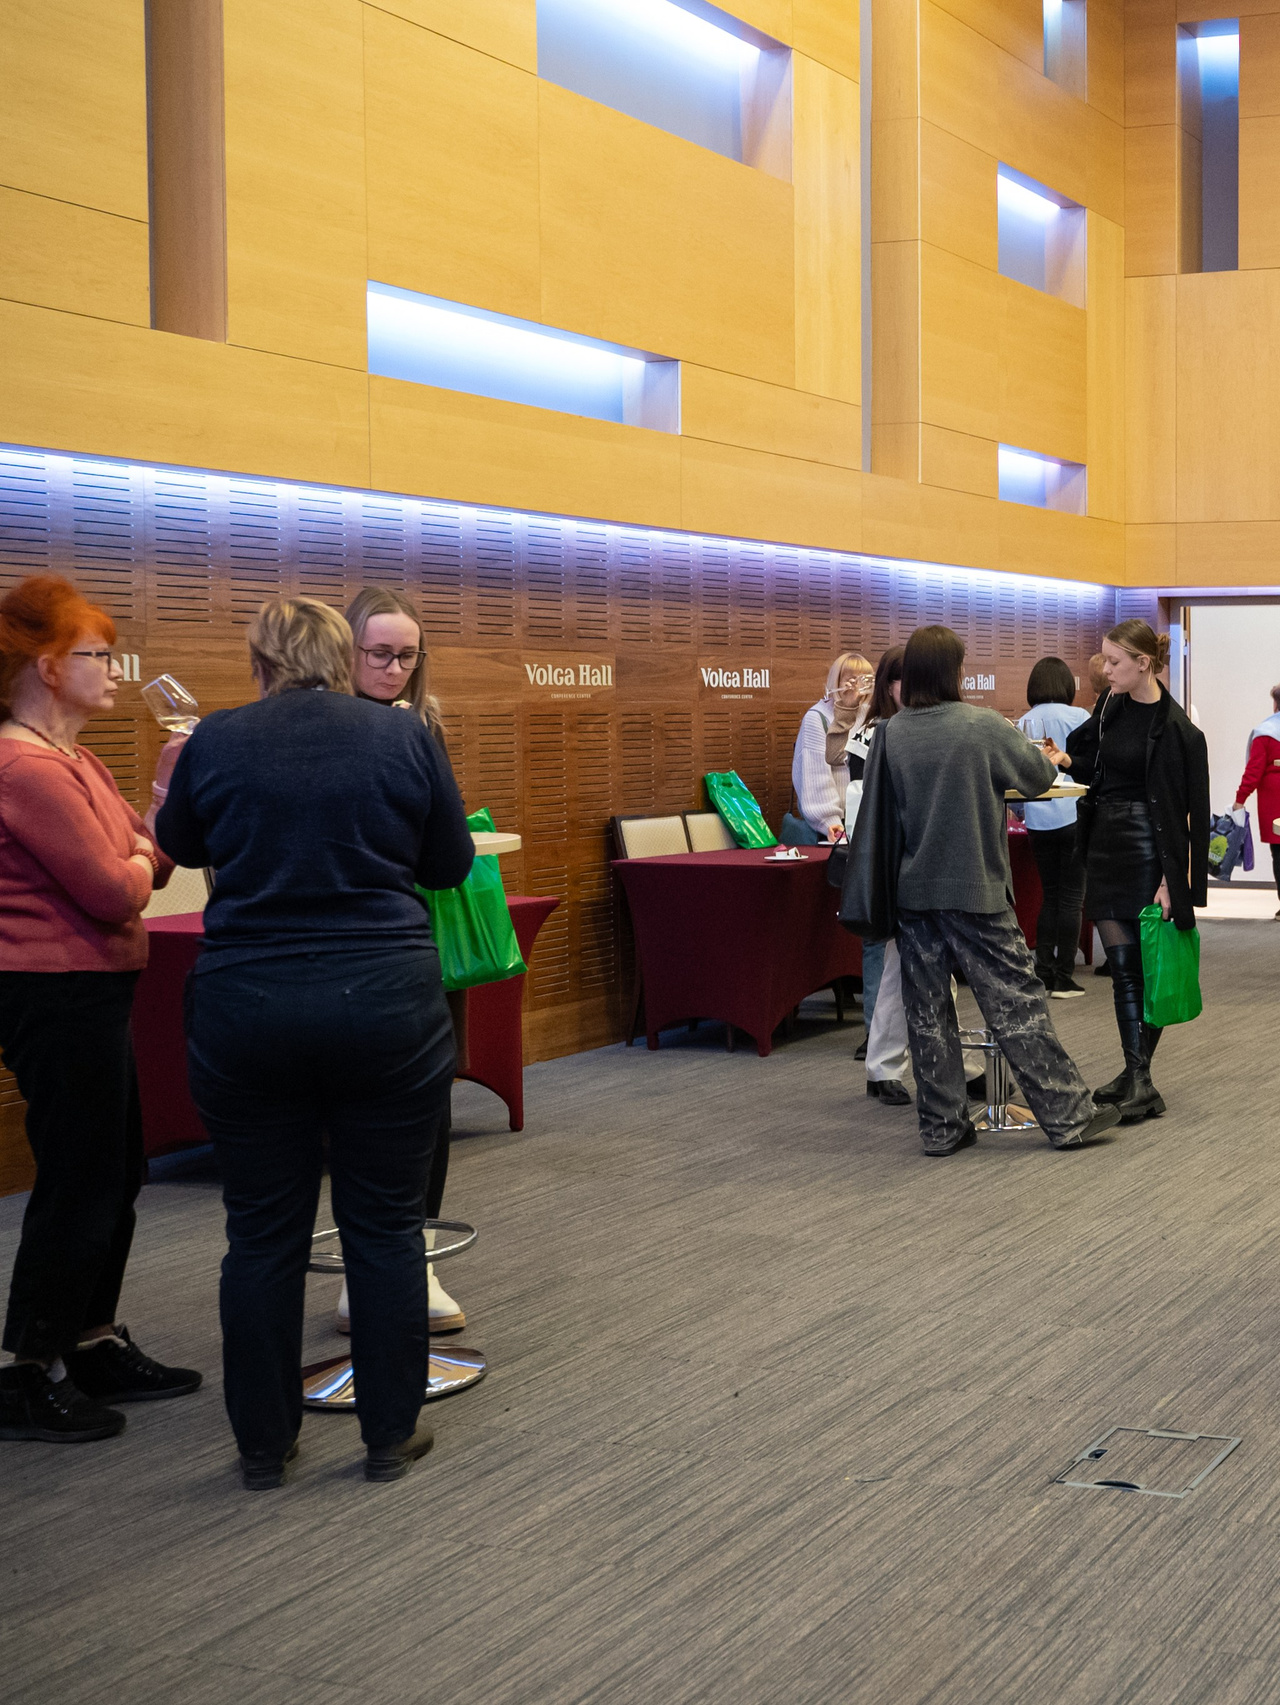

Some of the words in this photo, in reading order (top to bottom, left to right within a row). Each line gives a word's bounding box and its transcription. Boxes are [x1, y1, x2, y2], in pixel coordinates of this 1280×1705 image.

[578, 664, 613, 687] Hall
[742, 668, 770, 688] Hall
[977, 674, 996, 691] Hall
